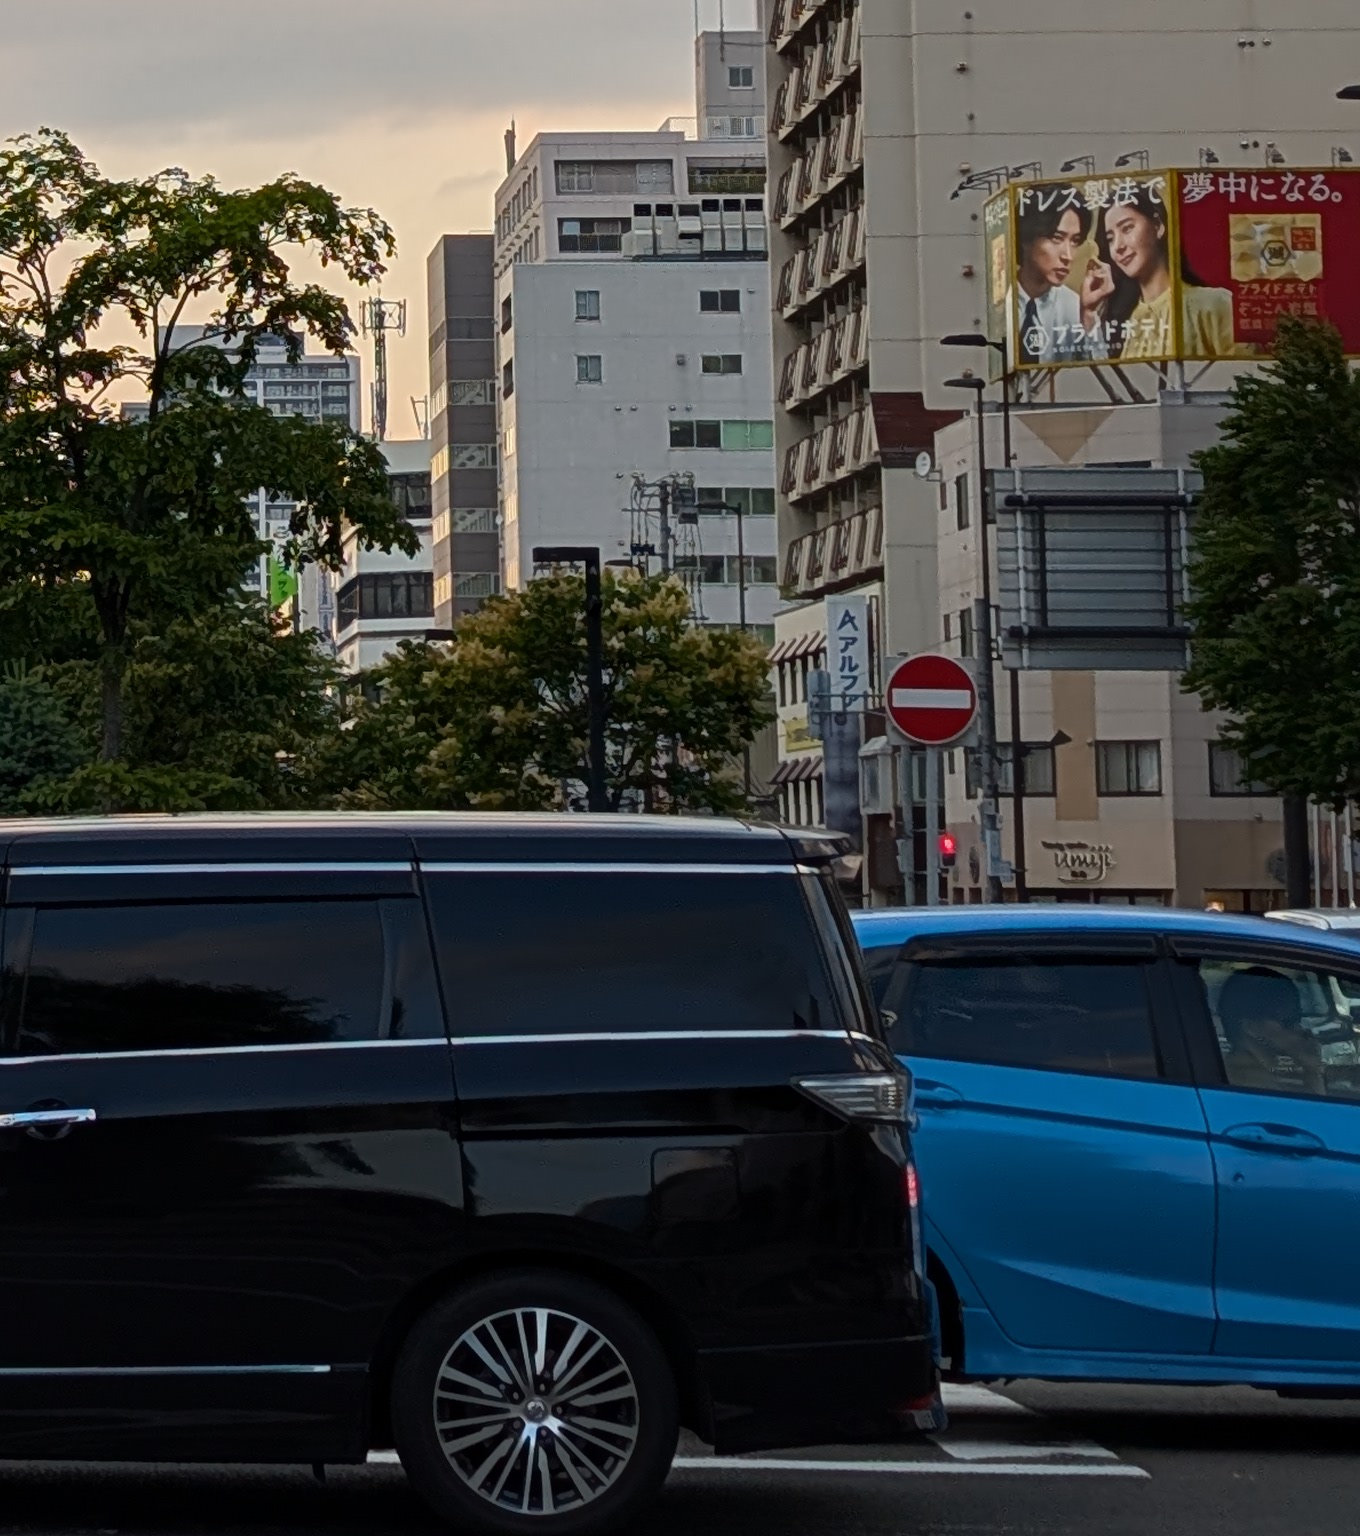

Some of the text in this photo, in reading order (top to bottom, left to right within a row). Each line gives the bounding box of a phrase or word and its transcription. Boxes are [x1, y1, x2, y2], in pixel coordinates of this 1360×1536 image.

[1016, 176, 1166, 217] ドレス製法で
[1182, 172, 1343, 204] 夢中になる。
